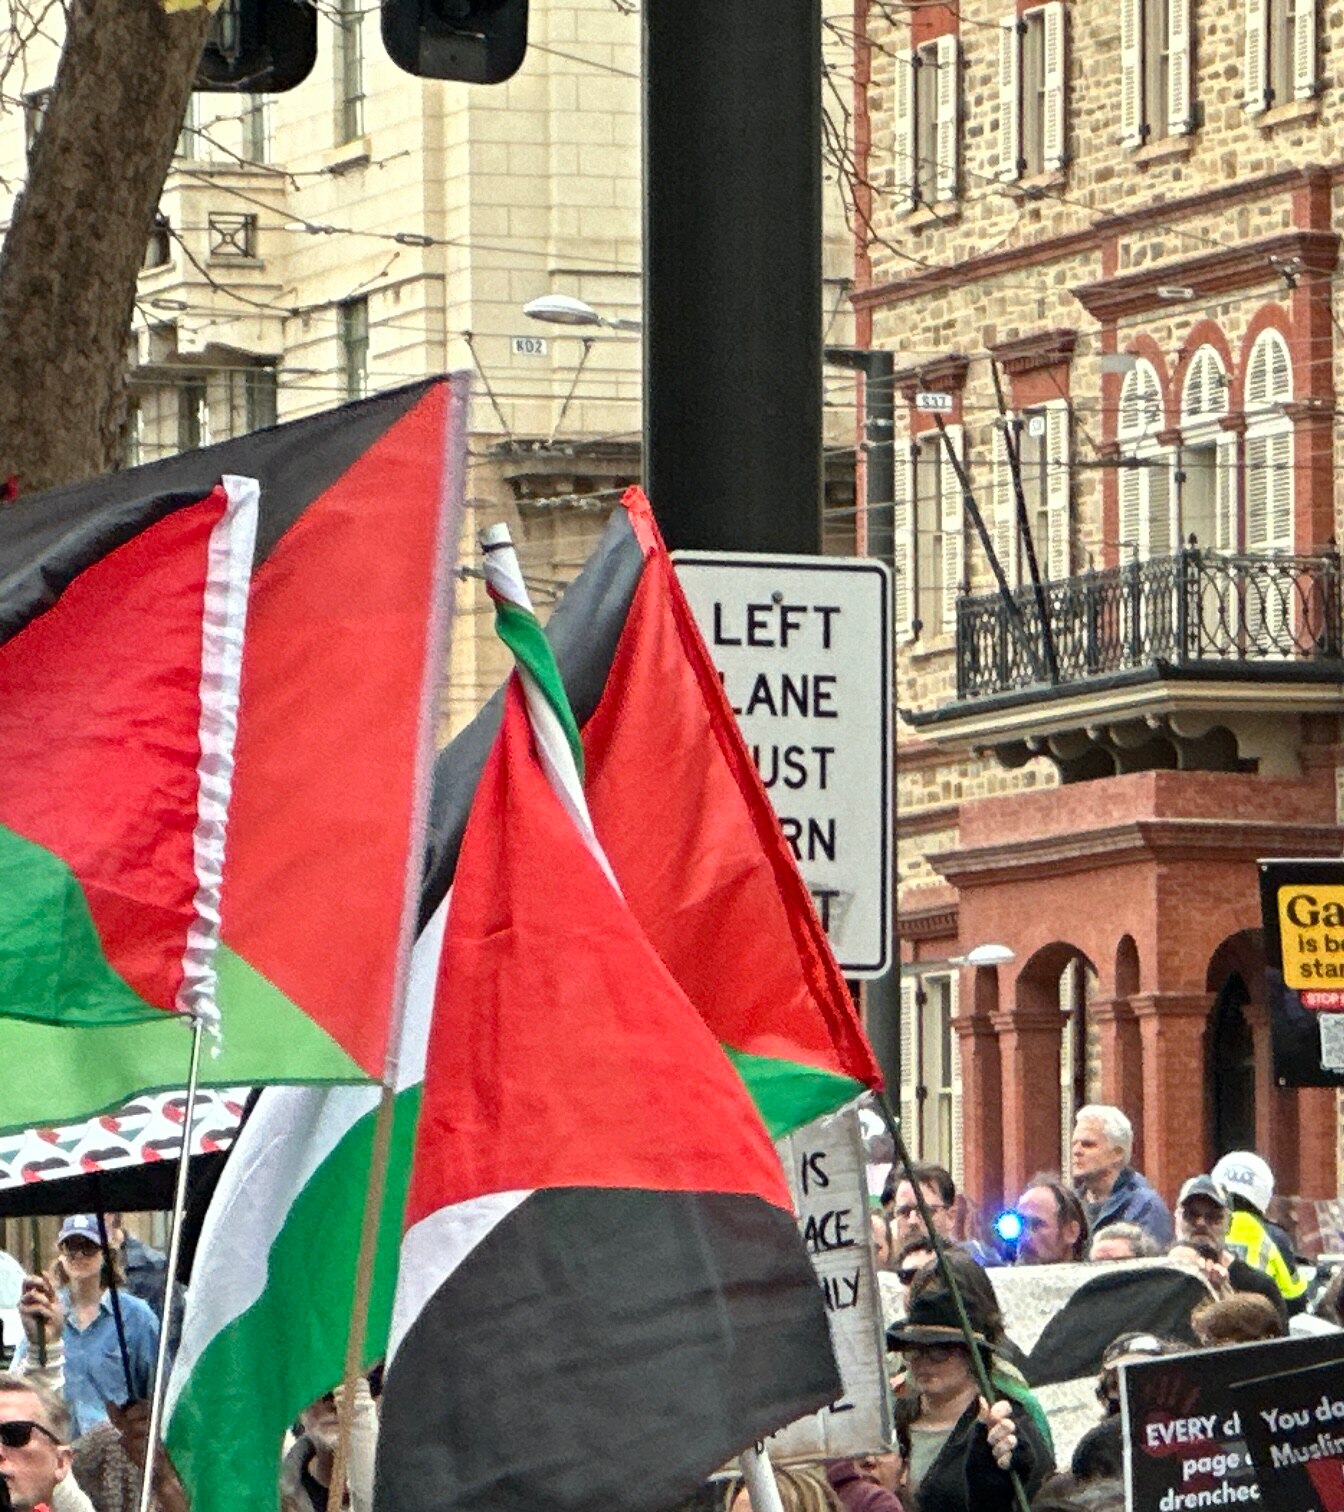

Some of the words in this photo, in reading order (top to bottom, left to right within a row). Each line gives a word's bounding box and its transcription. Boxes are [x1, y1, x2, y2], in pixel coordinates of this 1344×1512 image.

[713, 602, 841, 650] LEFT
[751, 745, 836, 790] UST
[1306, 991, 1340, 1006] STOP
[1145, 1413, 1218, 1447] EVERY
[1260, 1408, 1310, 1436] You
[1182, 1452, 1240, 1482] page
